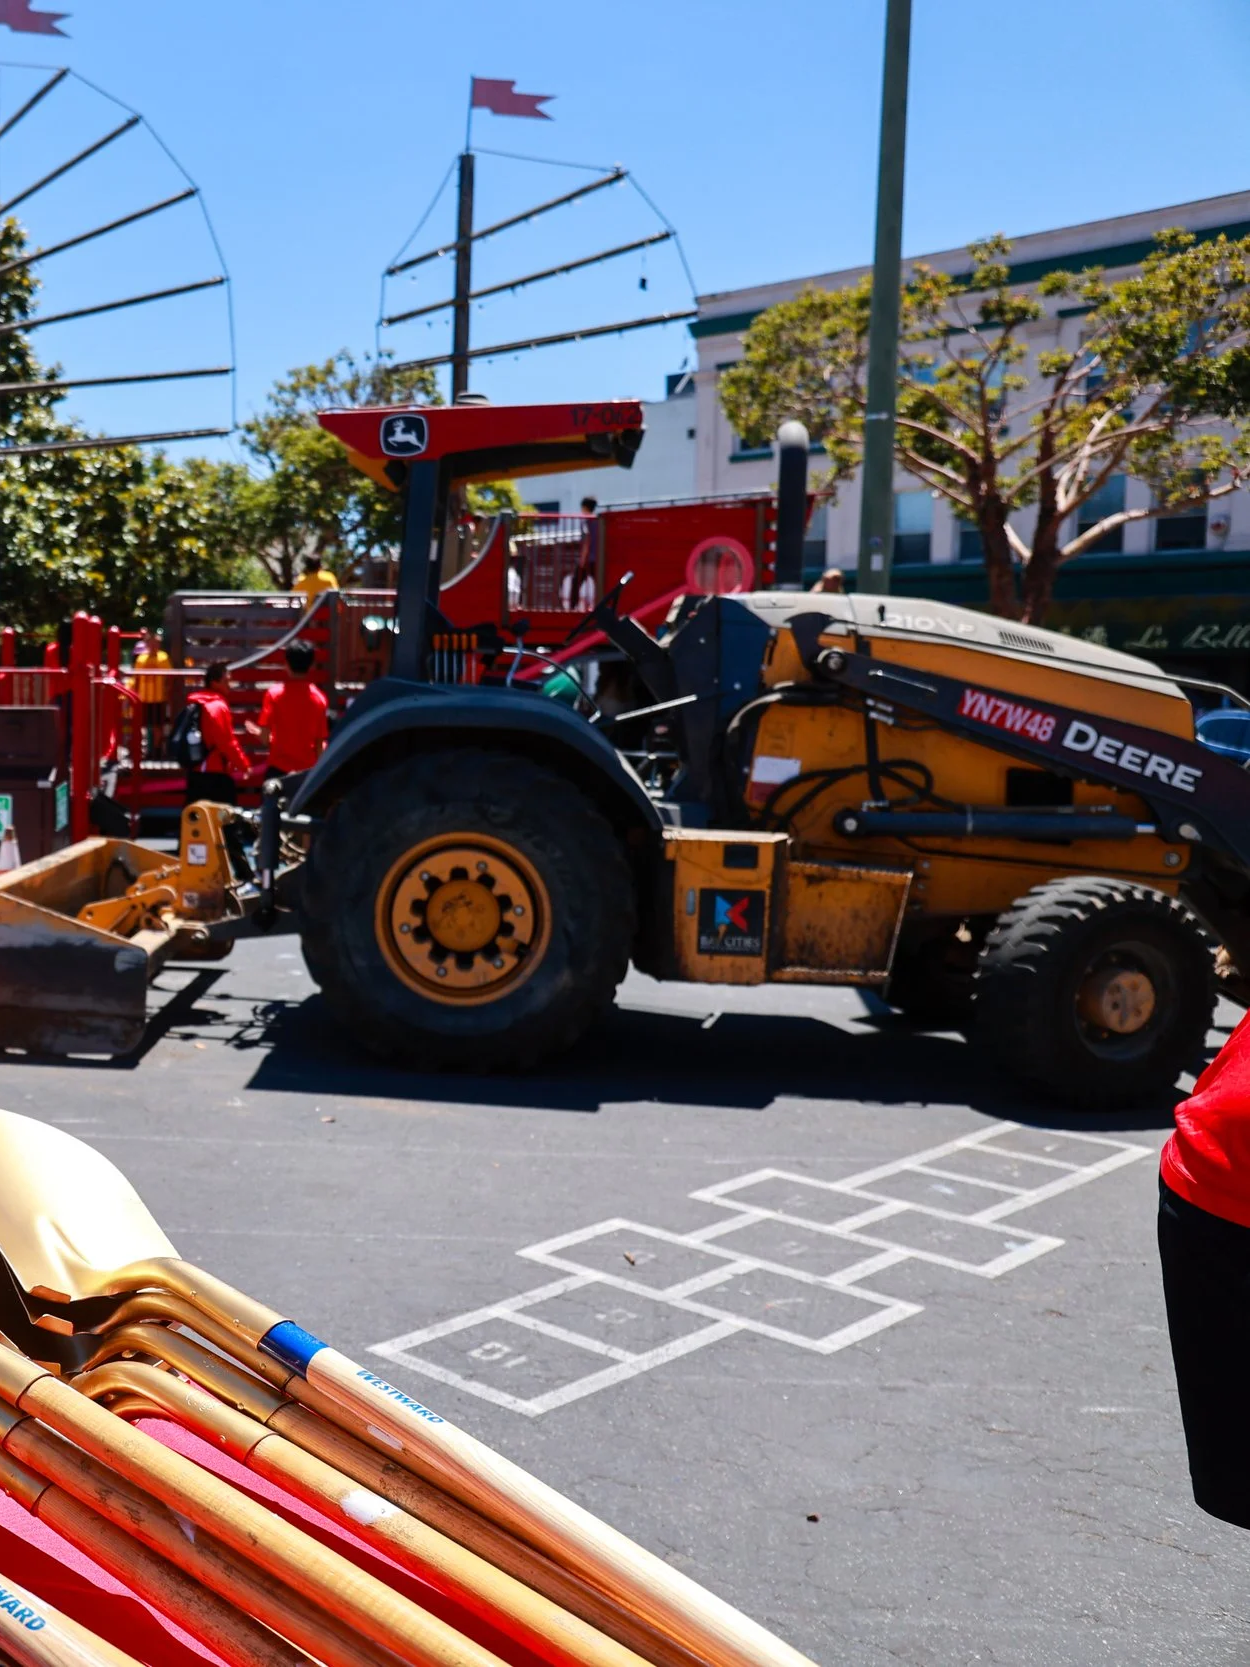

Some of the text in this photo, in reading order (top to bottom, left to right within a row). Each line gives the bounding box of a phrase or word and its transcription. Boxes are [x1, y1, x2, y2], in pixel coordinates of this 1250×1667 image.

[961, 688, 1056, 743] YN7W48
[1061, 720, 1203, 793] DEERE
[357, 1368, 444, 1424] WESTWARD
